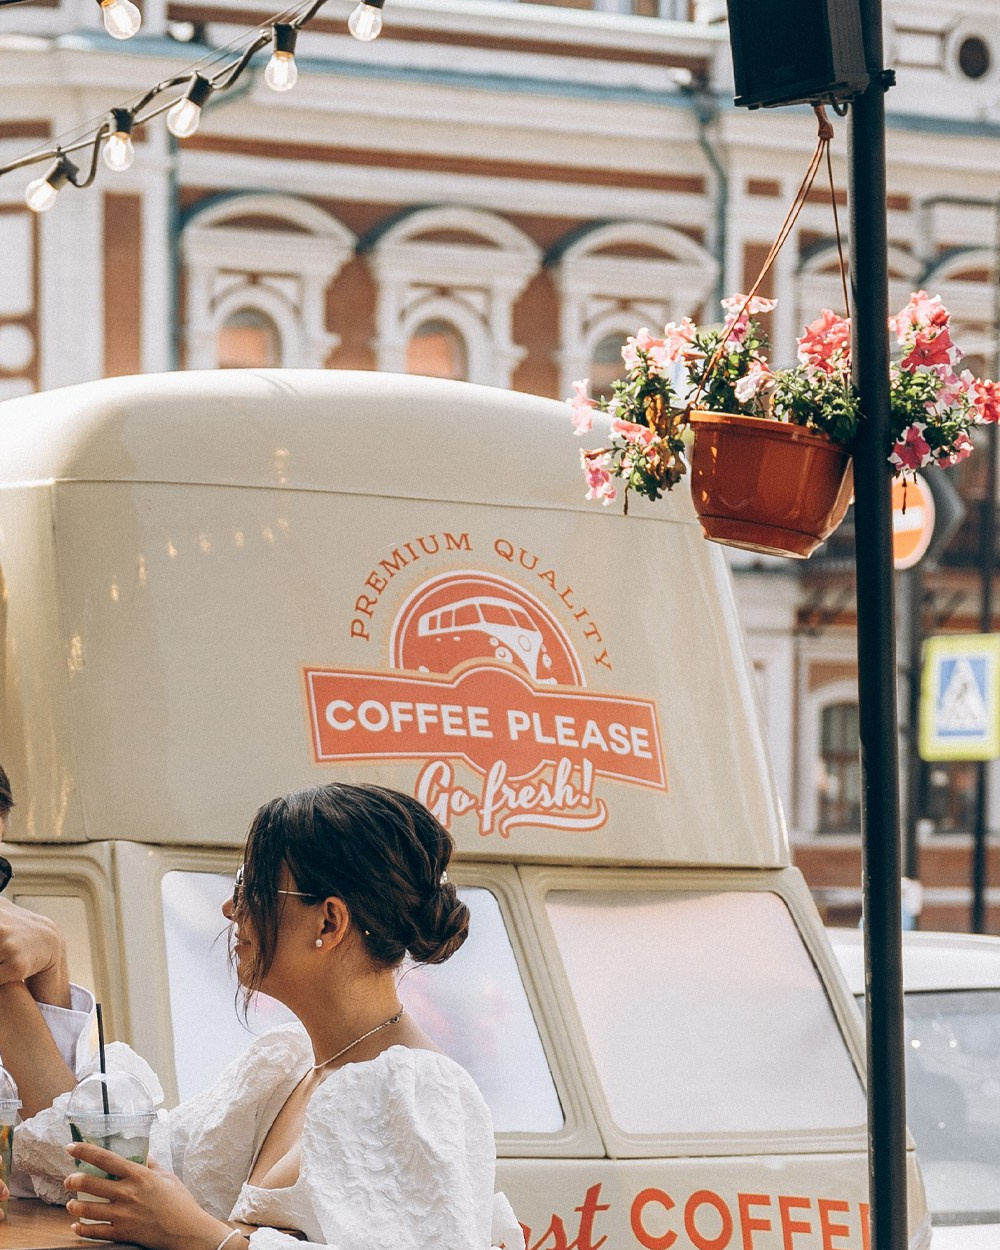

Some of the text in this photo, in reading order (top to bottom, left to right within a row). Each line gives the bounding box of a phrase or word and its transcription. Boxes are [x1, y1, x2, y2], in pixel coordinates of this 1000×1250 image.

[350, 532, 614, 672] PREMIUM QUALITY
[324, 699, 651, 759] COFFEE PLEASE
[416, 756, 594, 833] Go fresh!
